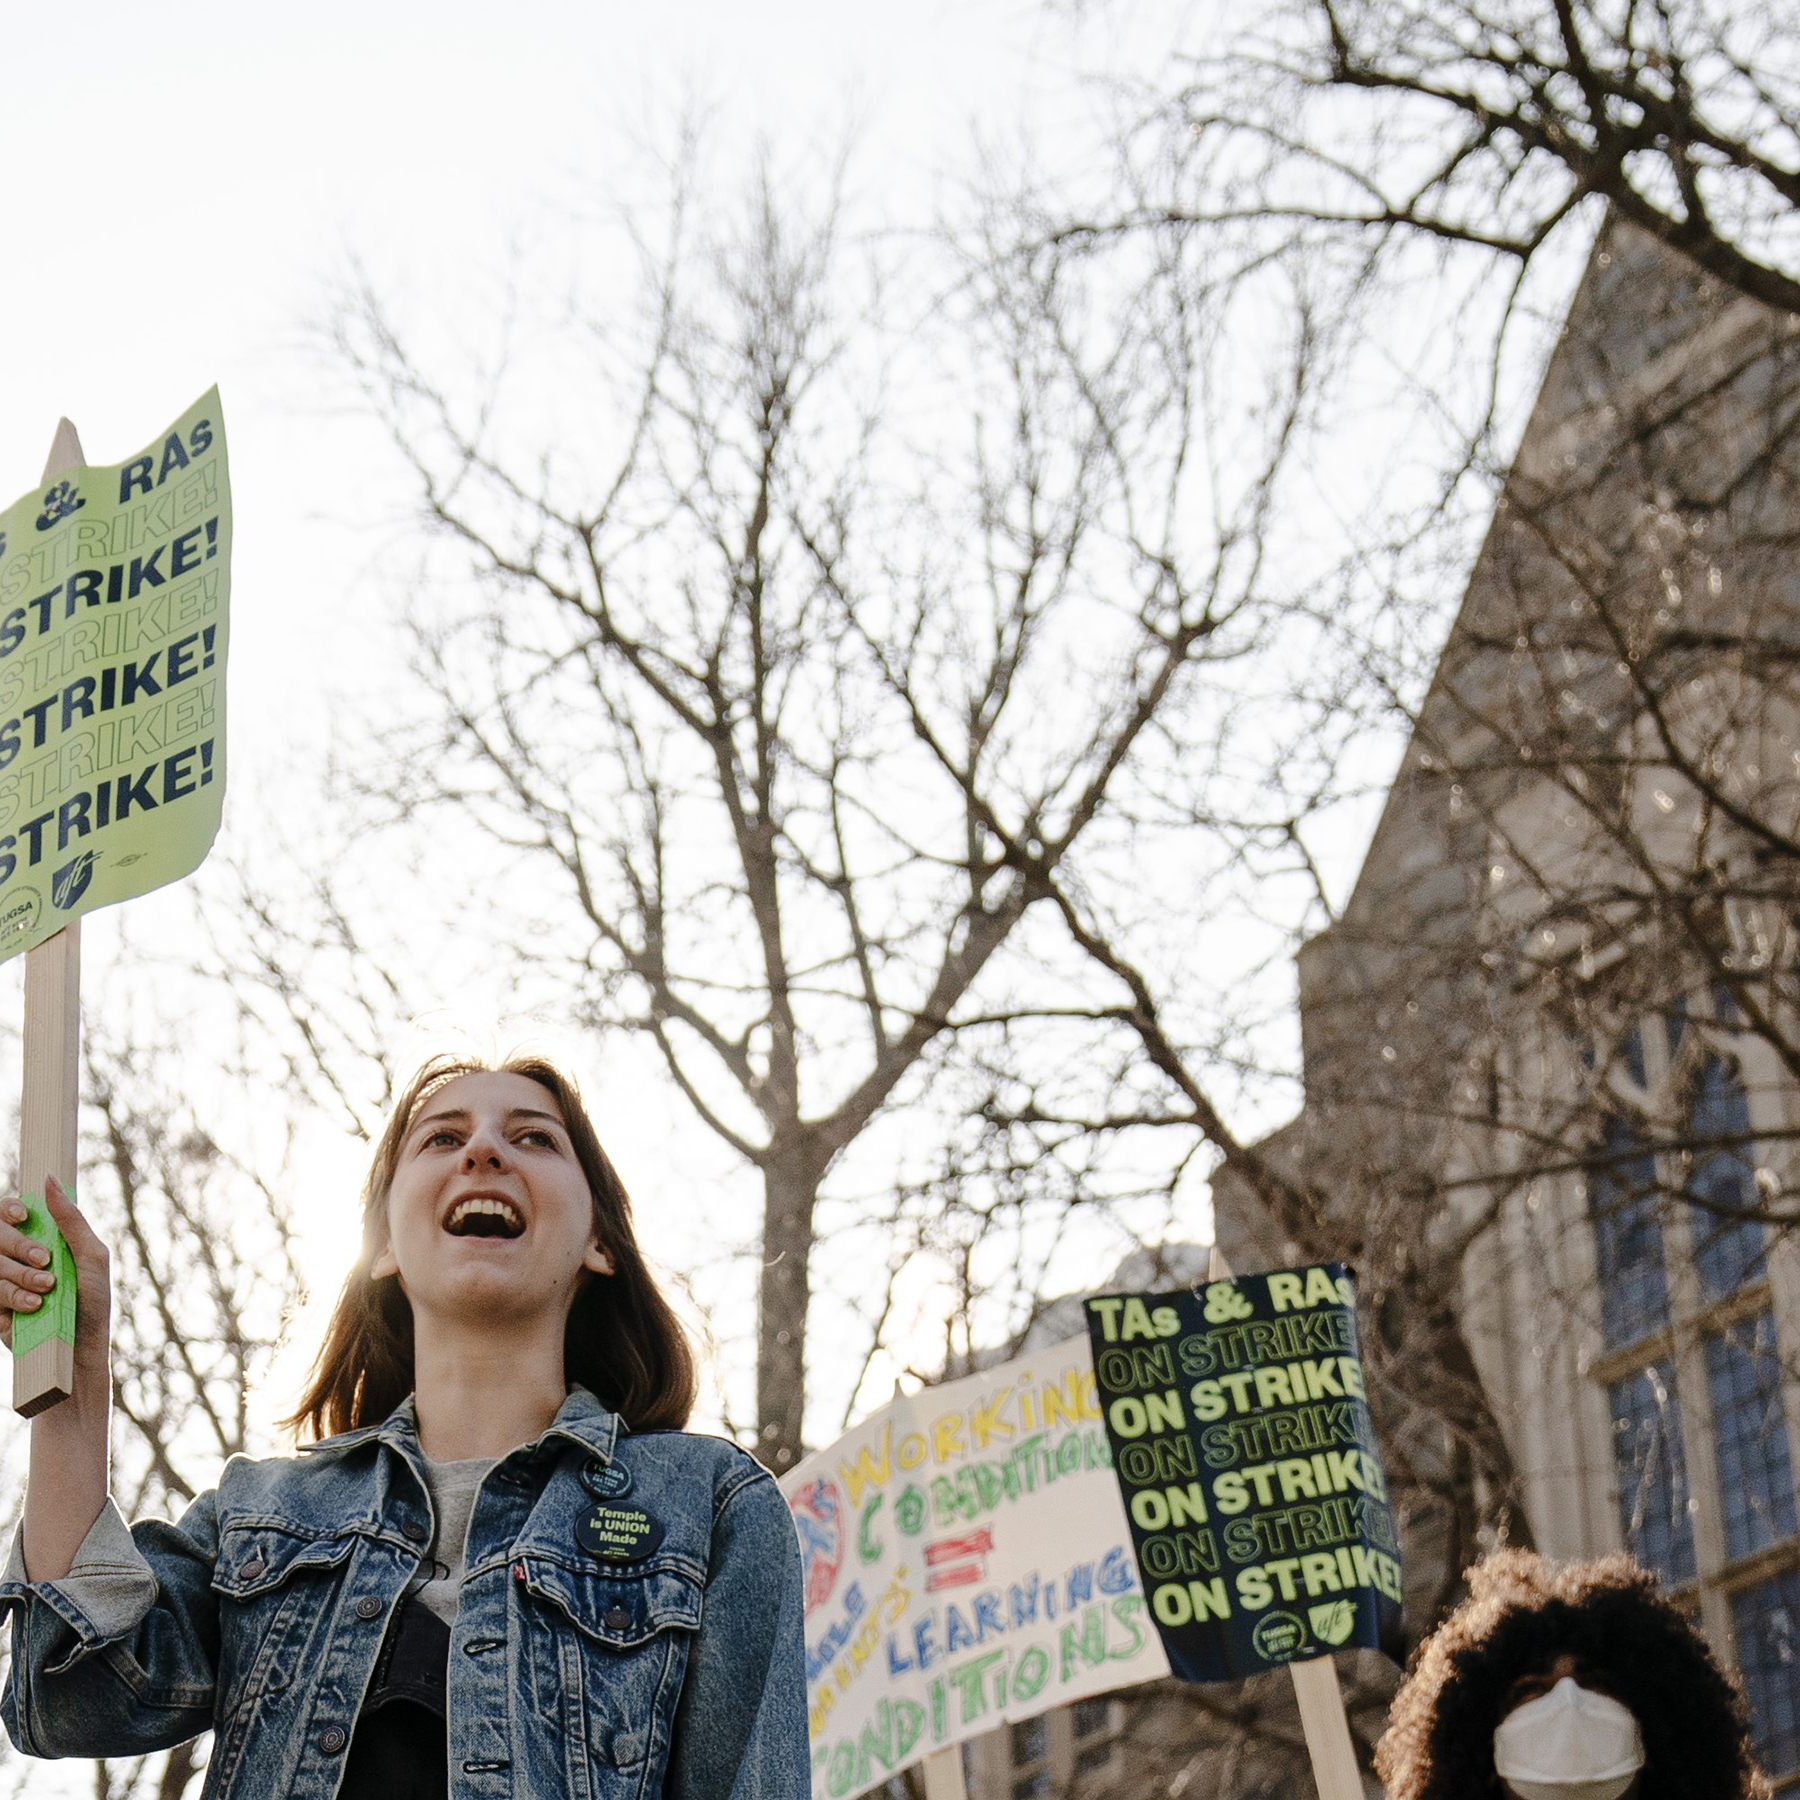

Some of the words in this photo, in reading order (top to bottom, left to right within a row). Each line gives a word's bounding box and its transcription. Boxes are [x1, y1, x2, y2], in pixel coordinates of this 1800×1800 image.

[36, 481, 86, 531] &
[119, 418, 213, 504] RAs
[0, 457, 219, 607] STRIKE!
[1090, 1298, 1181, 1341] TAs
[1204, 1283, 1253, 1324] &
[1099, 1344, 1176, 1393] ON
[1110, 1389, 1186, 1438] ON
[1119, 1434, 1198, 1486] ON
[597, 1507, 647, 1522] Temple
[605, 1520, 650, 1534] UNION
[1131, 1482, 1208, 1530] ON
[600, 1531, 637, 1545] Made
[1142, 1529, 1221, 1578] ON
[1153, 1577, 1231, 1627] ON
